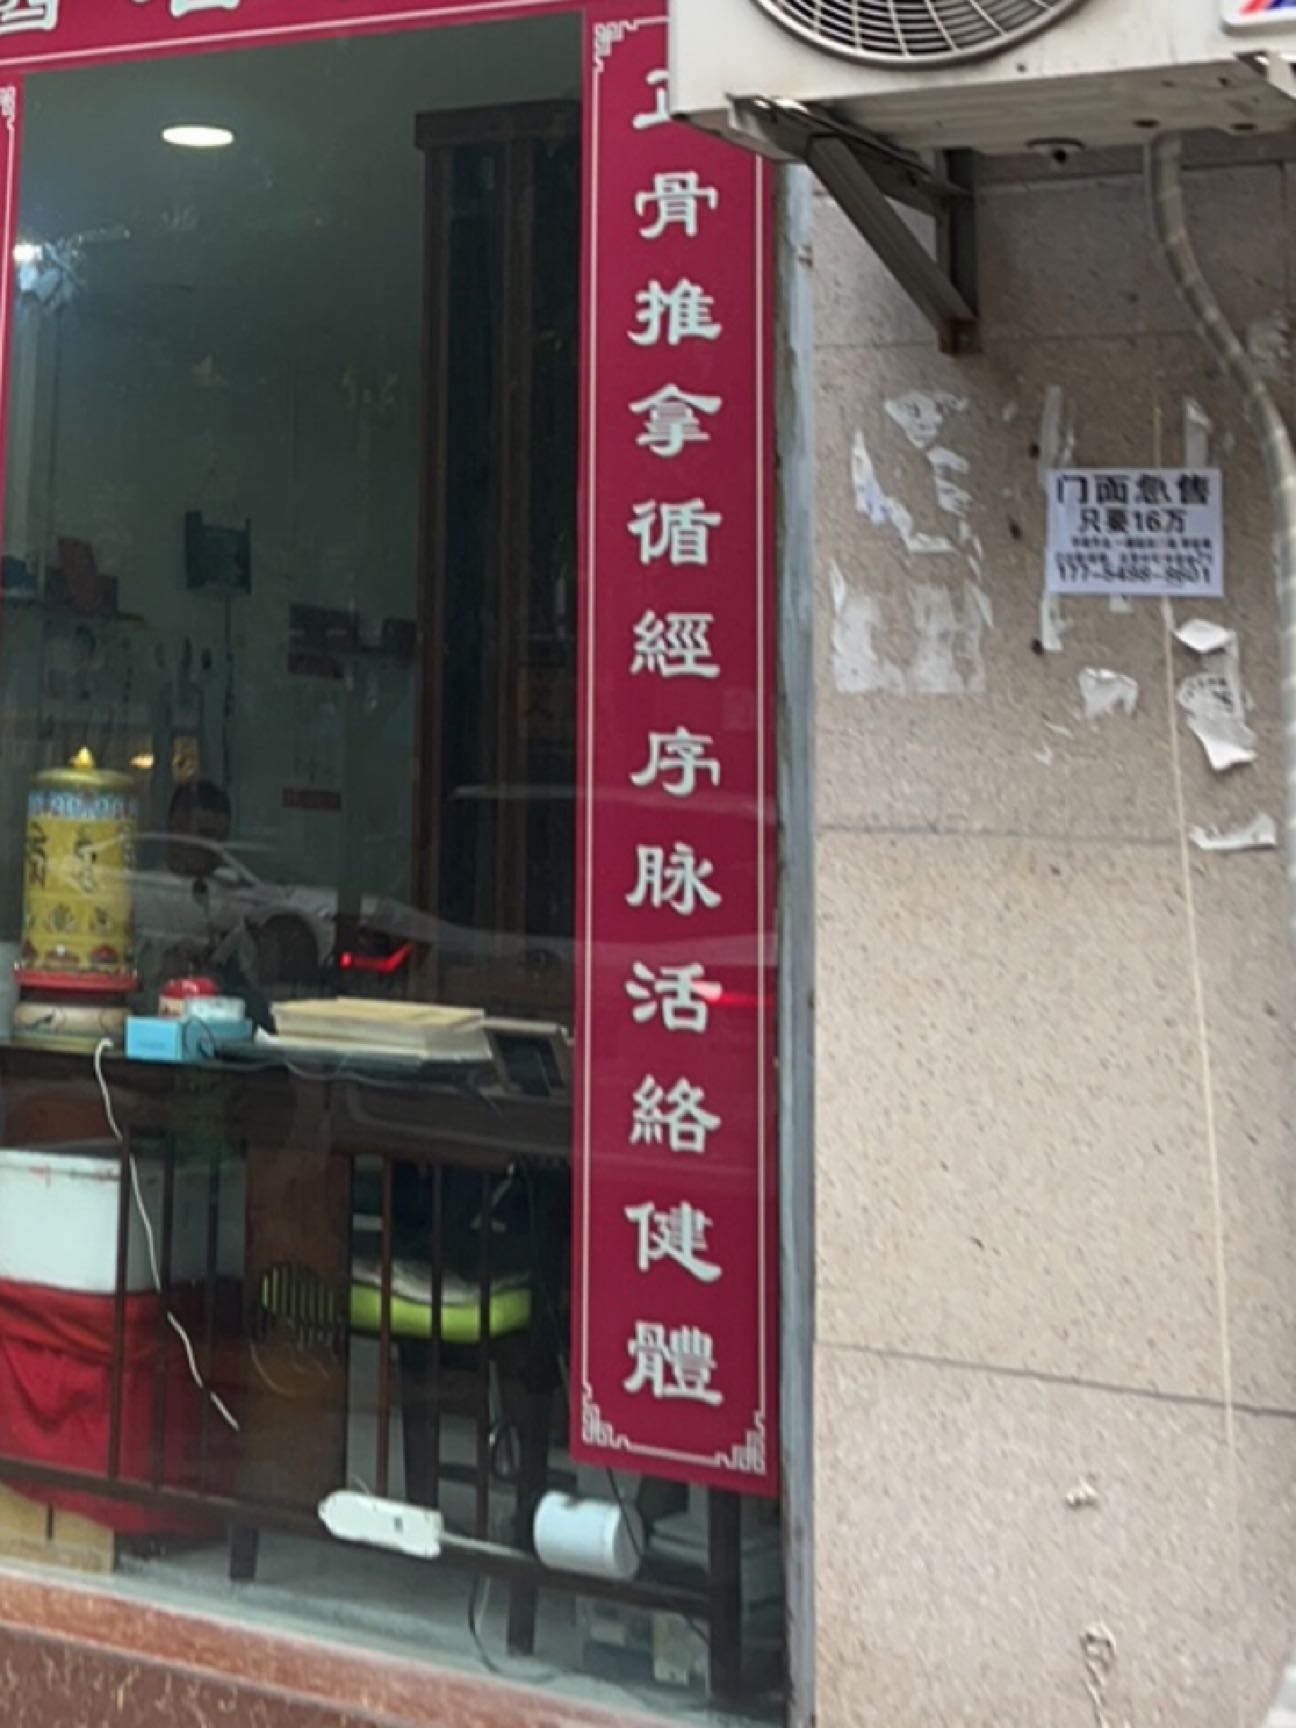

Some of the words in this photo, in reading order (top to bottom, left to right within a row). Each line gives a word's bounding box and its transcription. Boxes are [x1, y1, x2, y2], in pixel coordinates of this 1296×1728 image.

[1056, 473, 1210, 505] 门面急售
[1078, 508, 1188, 534] 只要16万
